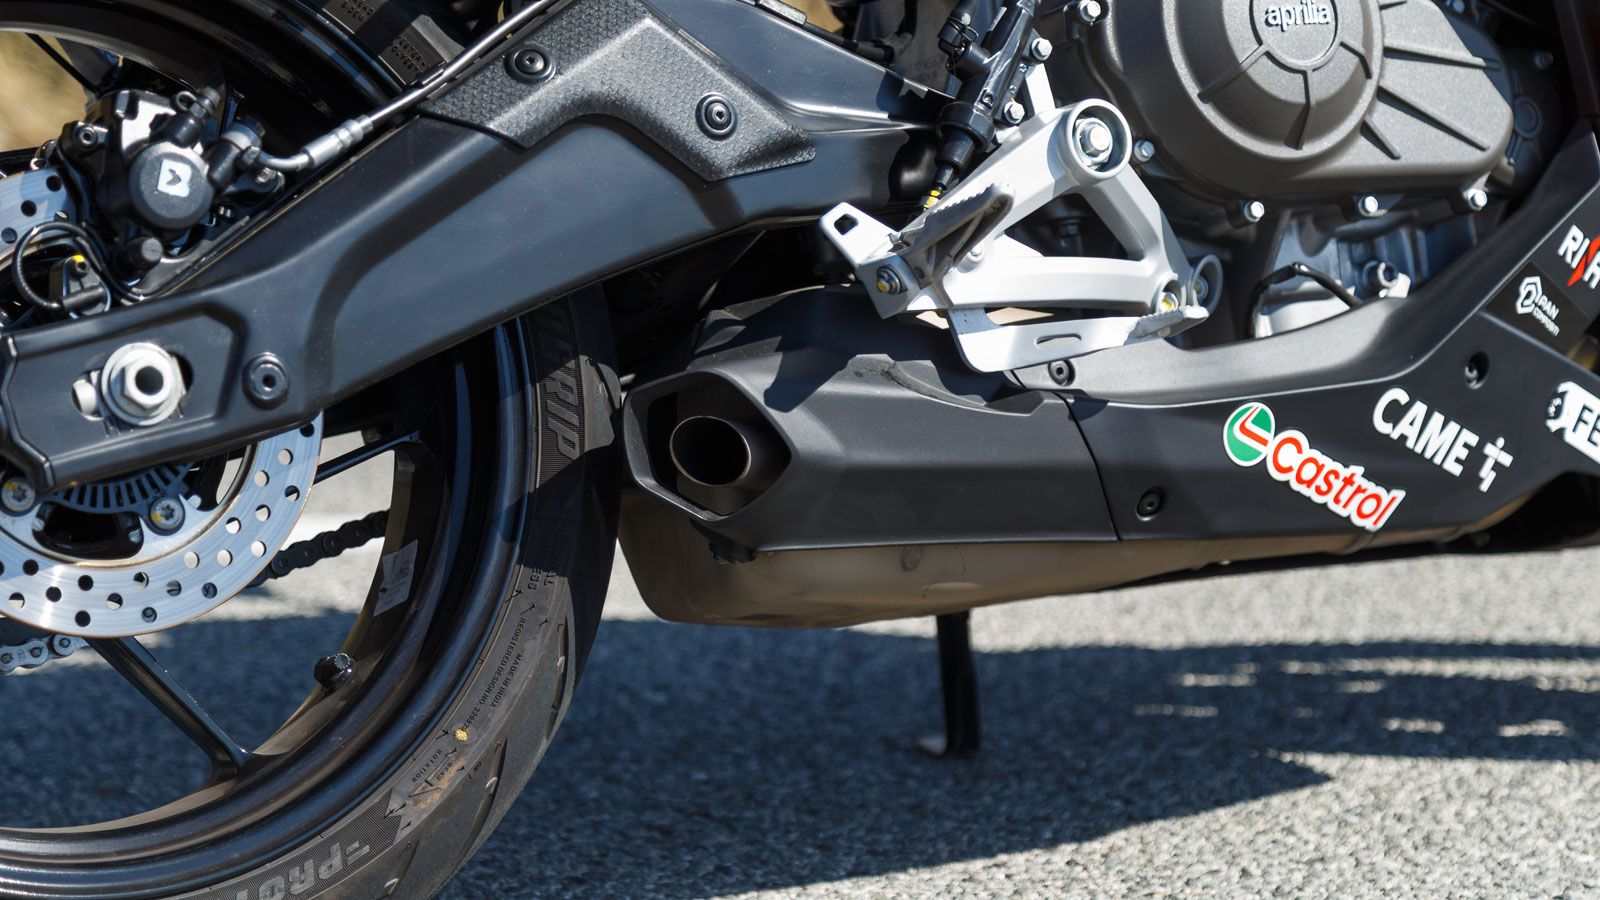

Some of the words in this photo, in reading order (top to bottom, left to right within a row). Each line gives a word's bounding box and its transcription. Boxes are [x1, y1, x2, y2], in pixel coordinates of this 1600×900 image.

[1264, 0, 1331, 32] aprilia
[1372, 387, 1480, 478] CAME
[1270, 433, 1400, 528] Castrol
[504, 652, 524, 678] MADE
[488, 684, 506, 710] INDIA
